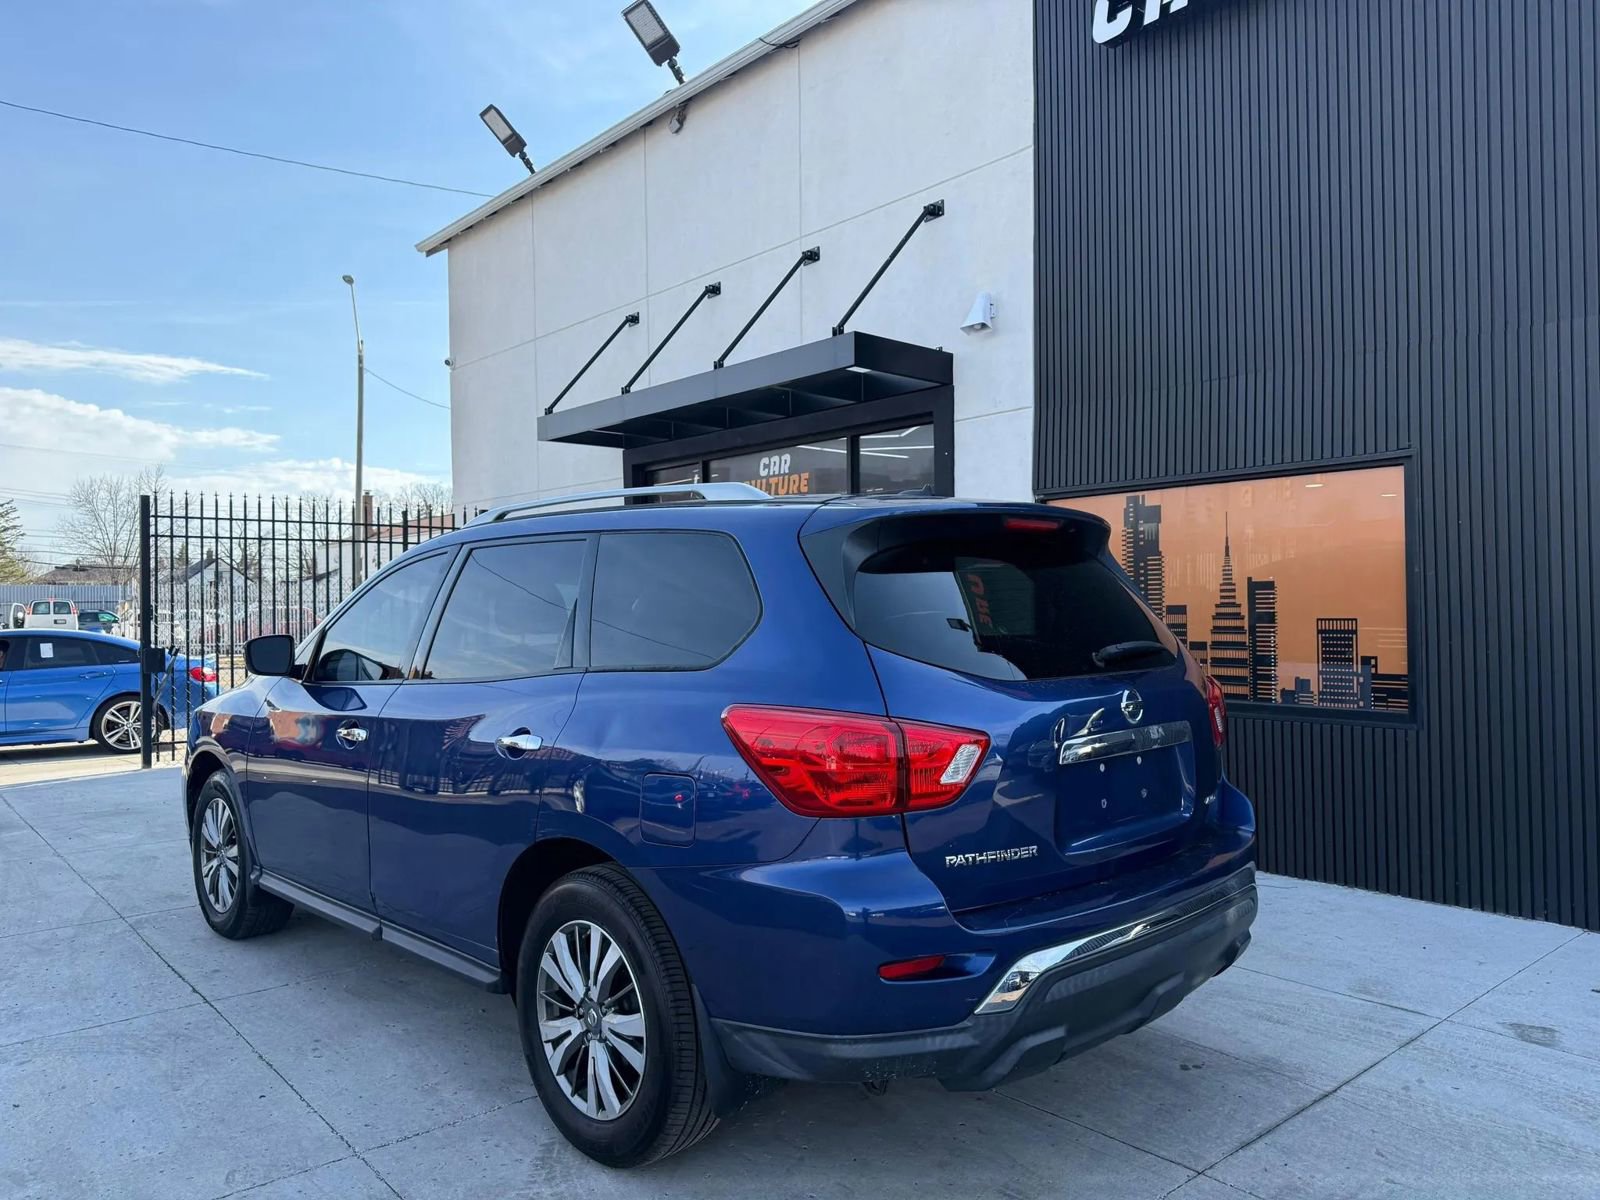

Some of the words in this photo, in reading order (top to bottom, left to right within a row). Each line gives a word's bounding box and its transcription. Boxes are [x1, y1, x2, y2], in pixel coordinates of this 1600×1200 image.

[759, 453, 791, 477] CAR
[744, 472, 809, 496] LTURE
[944, 845, 1039, 868] PATHFINDER
